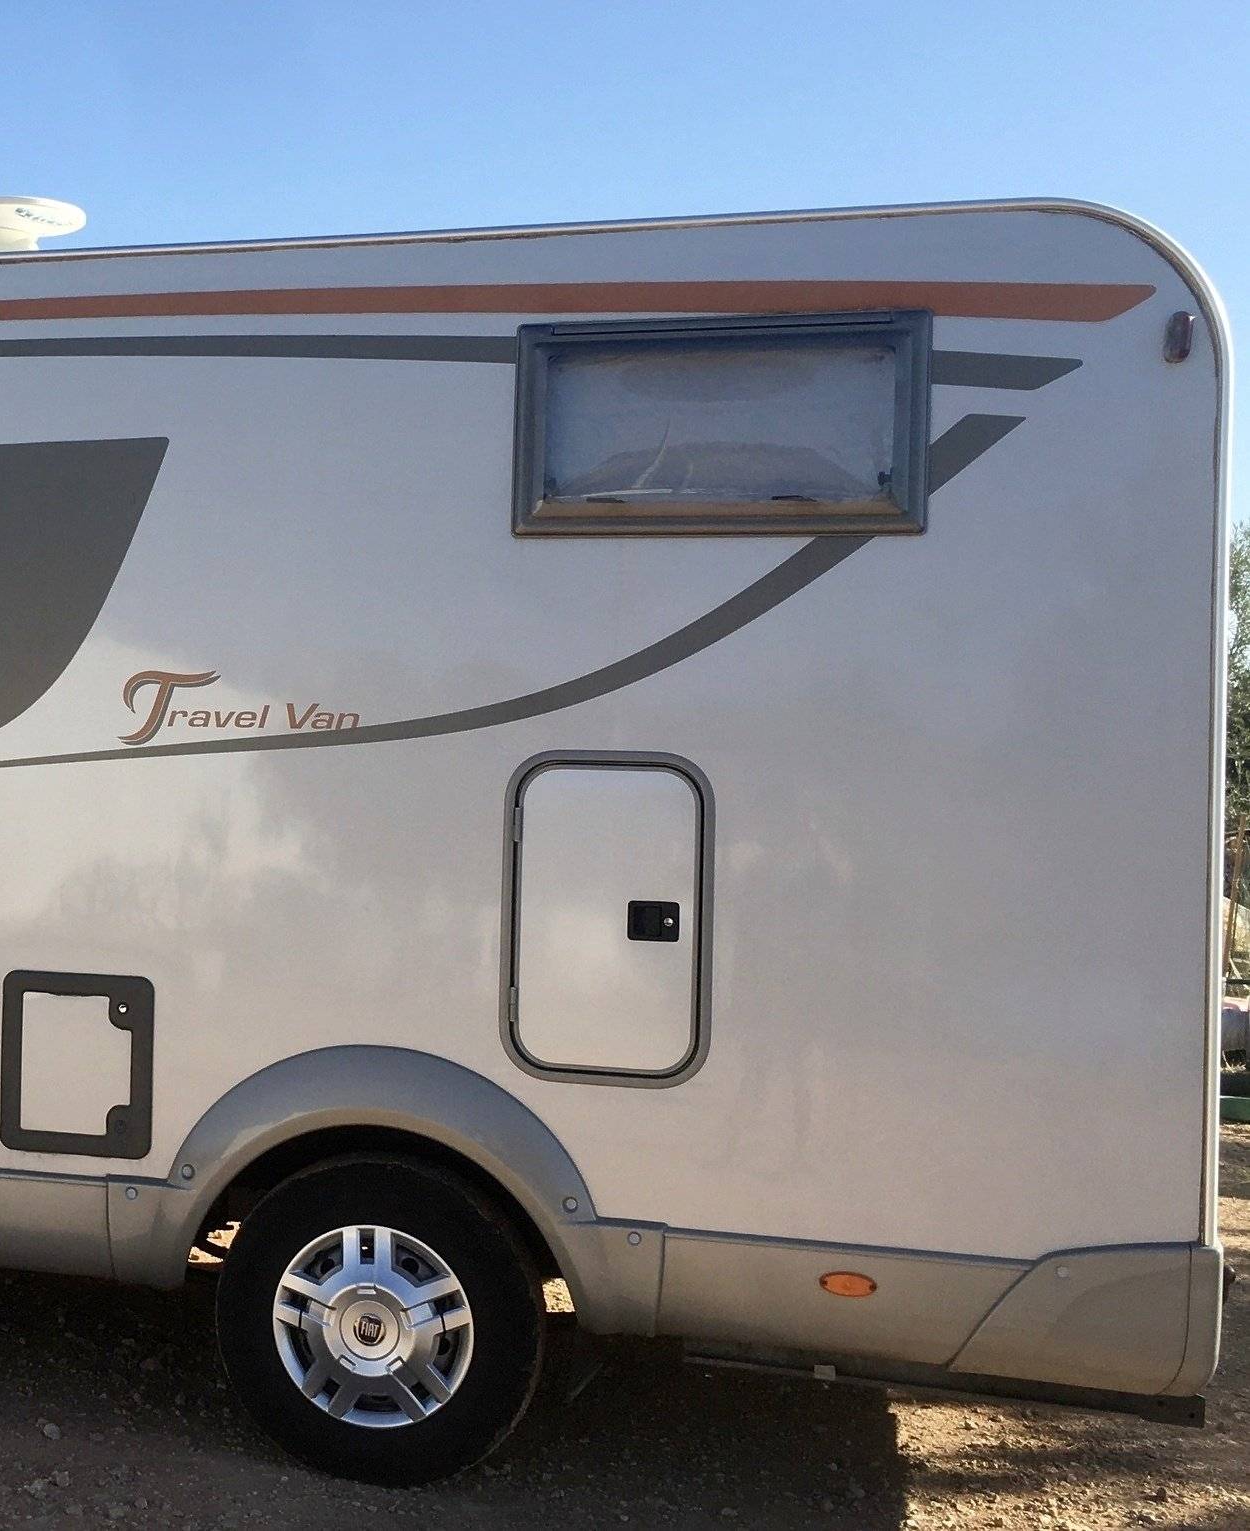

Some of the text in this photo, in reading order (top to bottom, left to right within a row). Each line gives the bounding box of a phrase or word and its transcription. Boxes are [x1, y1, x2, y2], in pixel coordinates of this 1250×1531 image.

[117, 670, 361, 745] Travel Van
[360, 1321, 380, 1338] FIAT
